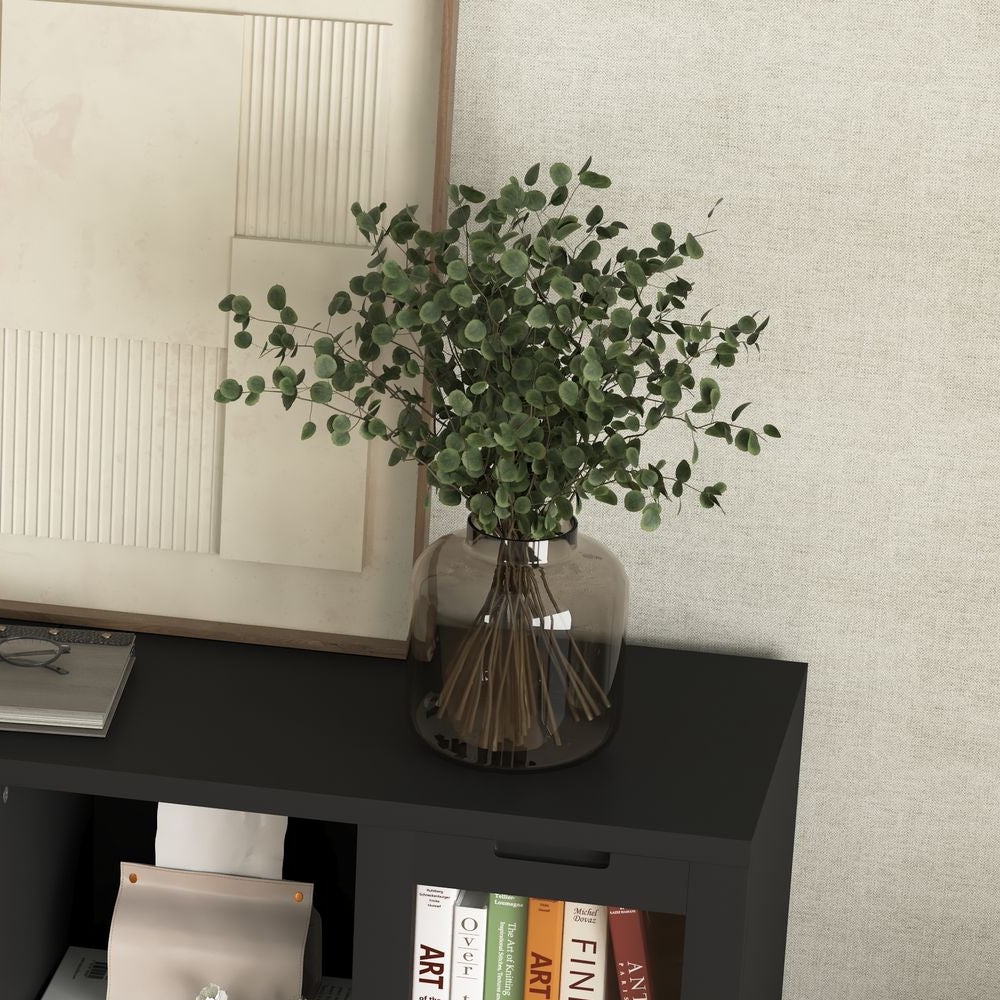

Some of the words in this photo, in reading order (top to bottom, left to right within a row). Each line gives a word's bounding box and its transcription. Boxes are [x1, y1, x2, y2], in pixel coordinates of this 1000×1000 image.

[573, 908, 599, 917] Michel
[507, 922, 517, 938] The
[506, 939, 516, 953] Art
[419, 944, 445, 990] ART
[506, 954, 515, 963] of
[502, 964, 515, 996] Knitting
[529, 951, 553, 1000] ART
[618, 962, 629, 1000] PARIS
